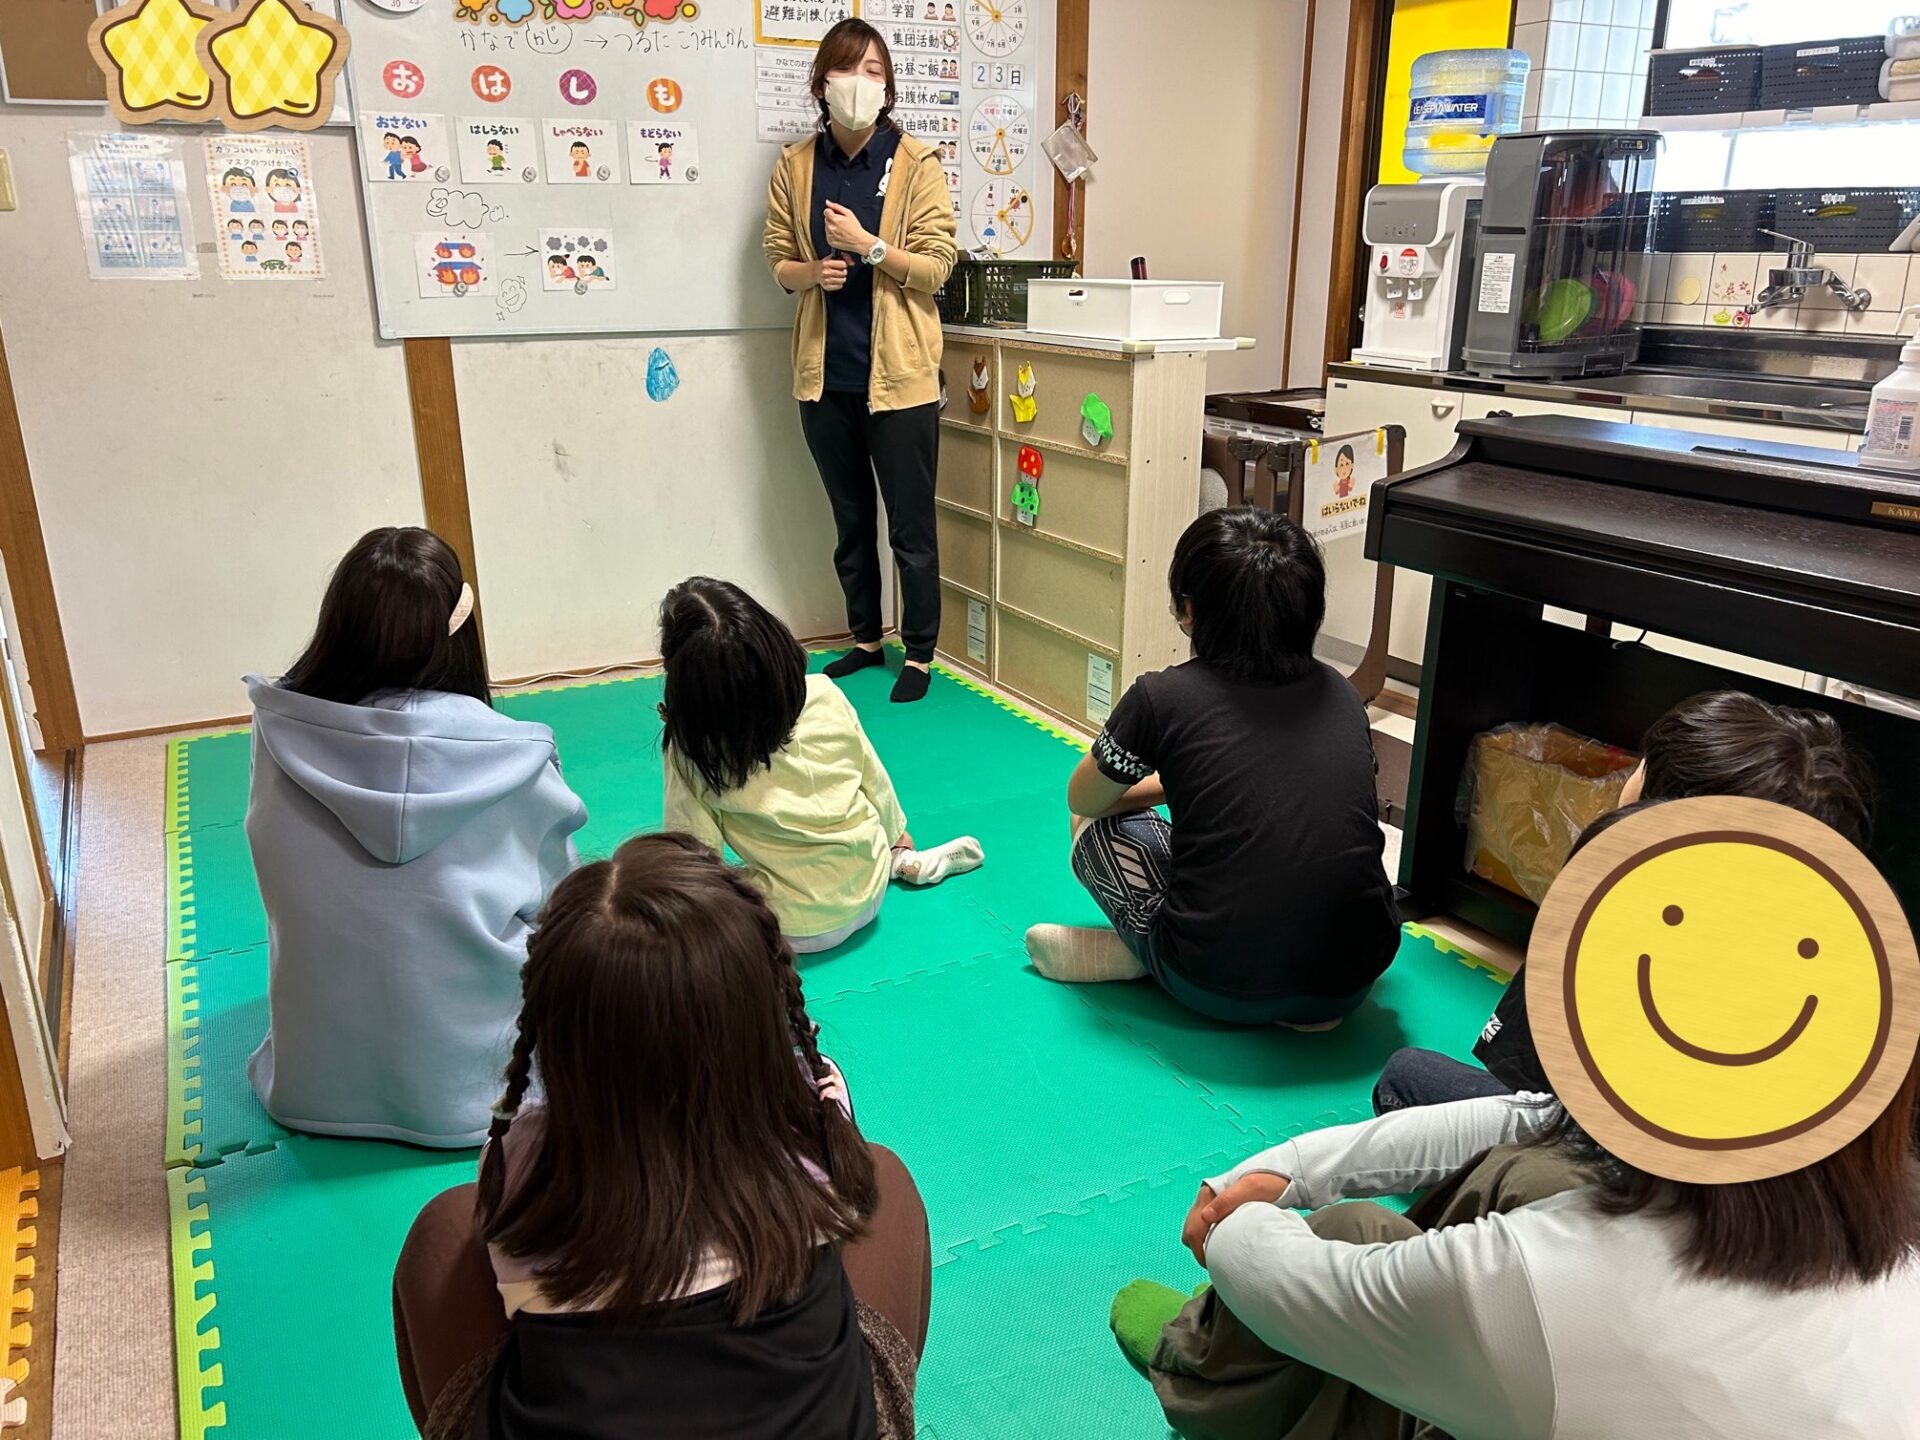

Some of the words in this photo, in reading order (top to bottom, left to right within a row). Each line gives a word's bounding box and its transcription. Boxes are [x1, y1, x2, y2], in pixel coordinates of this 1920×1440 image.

[892, 4, 914, 18] 学習
[893, 33, 940, 48] 集団活動
[893, 63, 940, 76] お昼ご飯
[392, 63, 420, 93] お
[478, 71, 507, 96] は
[569, 76, 589, 100] し
[653, 83, 676, 107] も
[895, 90, 939, 104] お腹休め
[376, 115, 428, 129] おさない
[895, 119, 940, 133] 自由時間
[469, 124, 520, 136] はしらない
[552, 126, 604, 137] しゃべらない
[639, 127, 683, 139] もどらない
[1322, 496, 1366, 517] はいらないでね
[1888, 506, 1920, 520] KAWA
